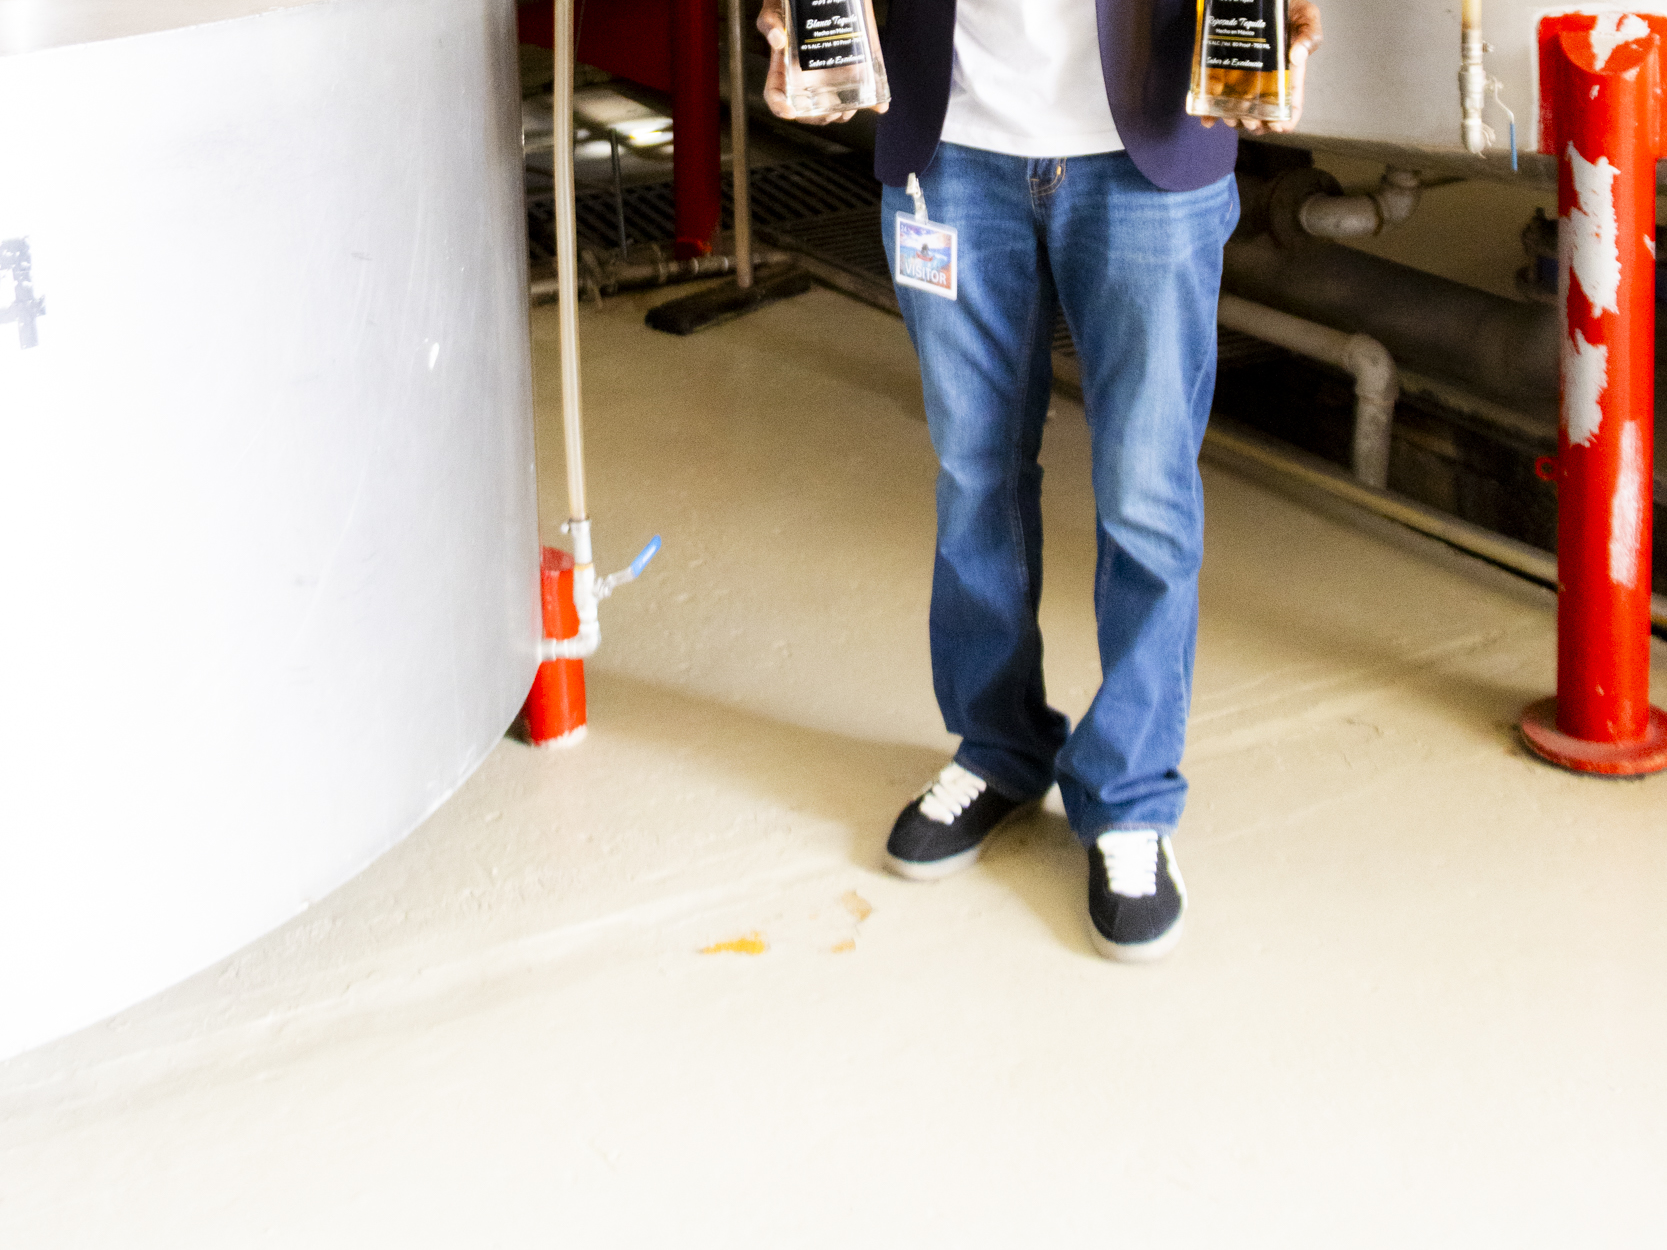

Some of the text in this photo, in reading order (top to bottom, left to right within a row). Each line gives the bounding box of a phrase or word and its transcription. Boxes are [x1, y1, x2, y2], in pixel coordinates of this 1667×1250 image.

[805, 14, 857, 29] Blanco Tequila
[1208, 15, 1266, 30] Reposado Tequila
[808, 60, 825, 68] Sabor
[826, 58, 834, 66] de
[1206, 56, 1222, 65] Sabor
[905, 262, 947, 285] VISITOR
